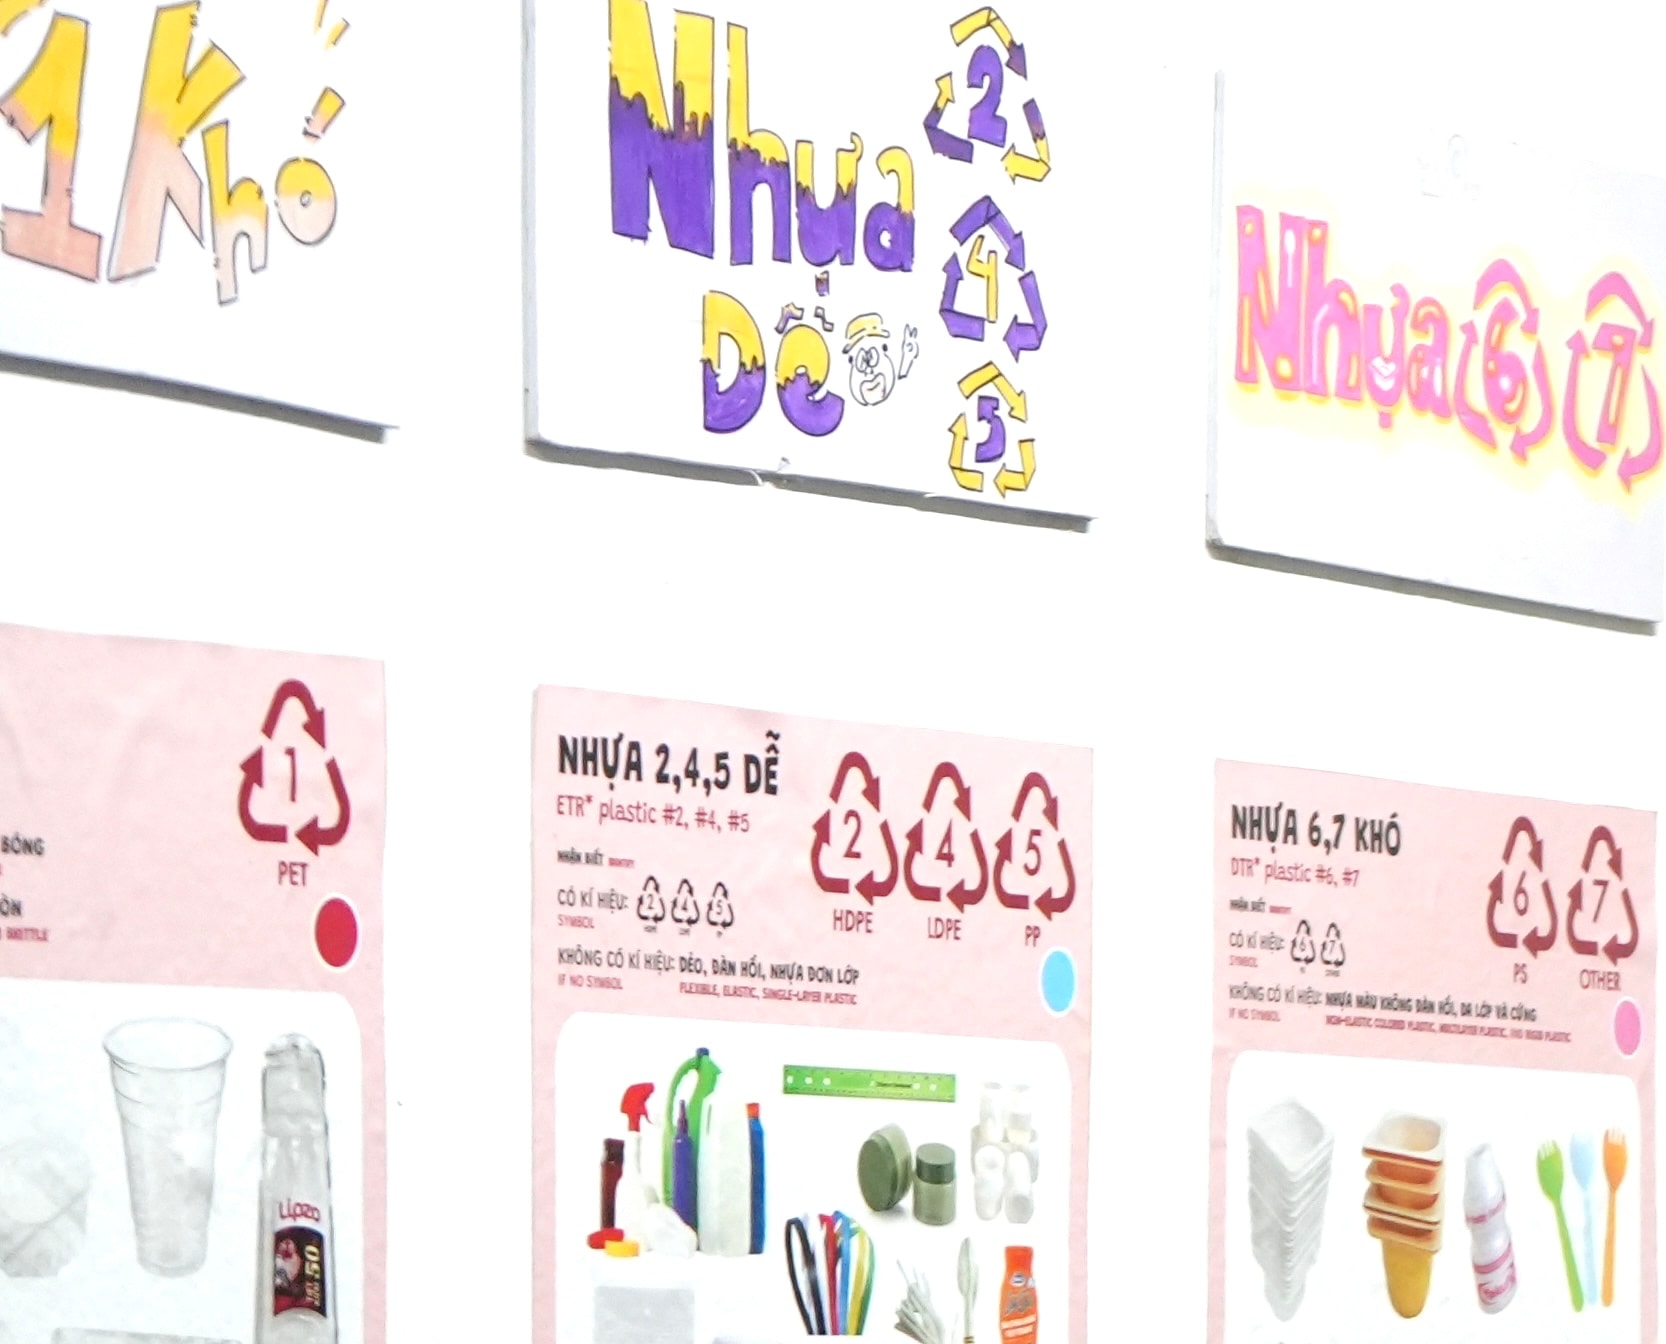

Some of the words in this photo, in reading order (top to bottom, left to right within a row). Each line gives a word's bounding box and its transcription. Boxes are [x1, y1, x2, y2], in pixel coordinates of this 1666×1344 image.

[608, 0, 917, 296] Nhựa
[558, 732, 643, 791] NHỰA
[655, 743, 730, 797] 2,4,5
[744, 729, 781, 795] DỄ
[599, 797, 657, 825] plastic
[662, 803, 689, 829] #2,
[695, 807, 722, 833] #4,
[728, 809, 750, 833] #5
[1231, 801, 1298, 854] NHỰA
[1308, 811, 1345, 856] 6,7
[1354, 812, 1401, 856] KHÓ
[277, 859, 309, 889] PET
[1265, 860, 1311, 884] plastic
[832, 908, 873, 934] HDPE
[927, 917, 962, 940] LDPE
[1025, 925, 1041, 947] PP
[1513, 962, 1528, 984] PS
[1579, 968, 1621, 991] OTHER
